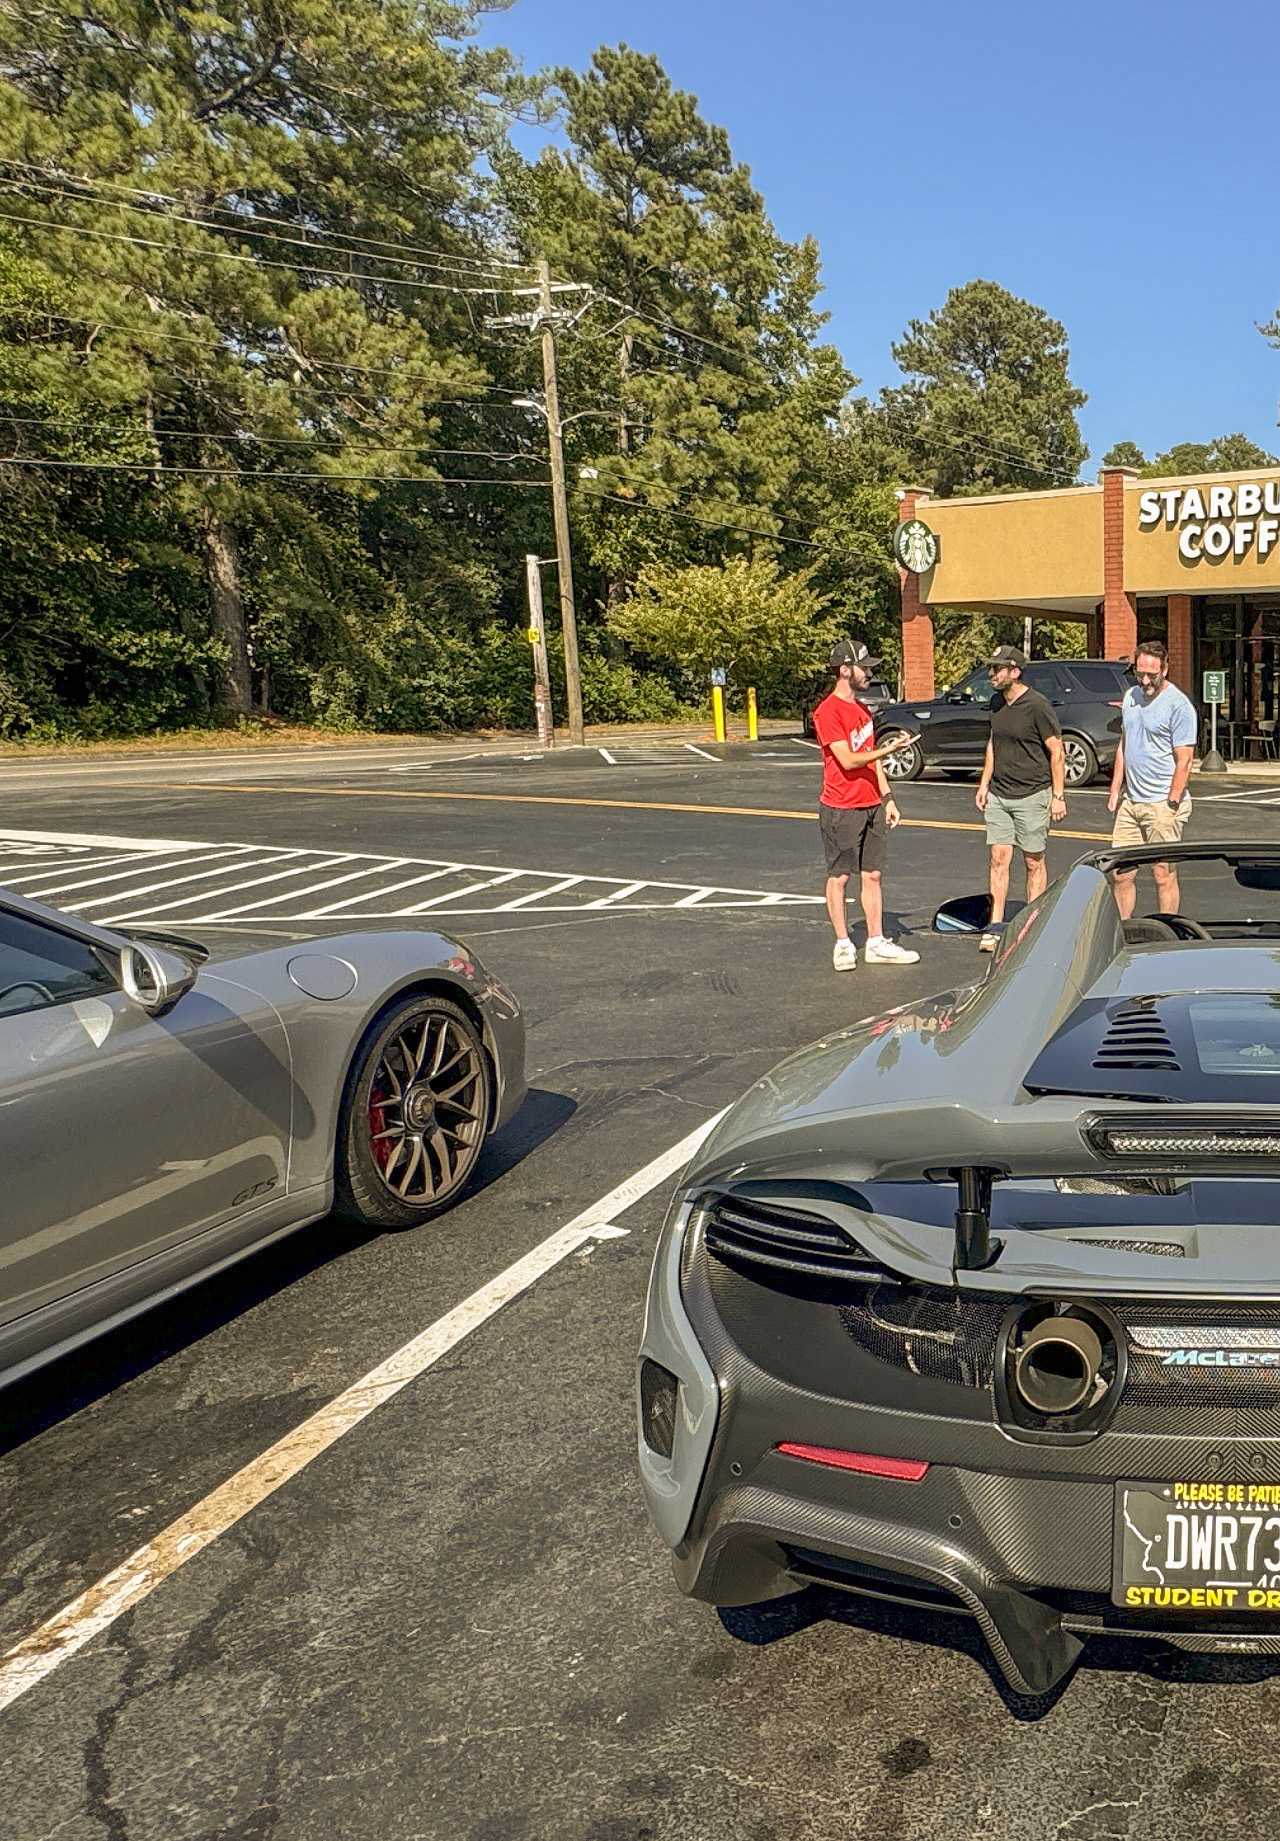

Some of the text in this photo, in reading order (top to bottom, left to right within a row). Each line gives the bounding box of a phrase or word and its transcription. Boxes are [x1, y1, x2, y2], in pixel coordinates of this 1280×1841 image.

[232, 1174, 278, 1207] GTS
[1174, 1483, 1224, 1502] PLEASE
[1228, 1485, 1244, 1502] BE
[1126, 1586, 1238, 1607] STUDENT
